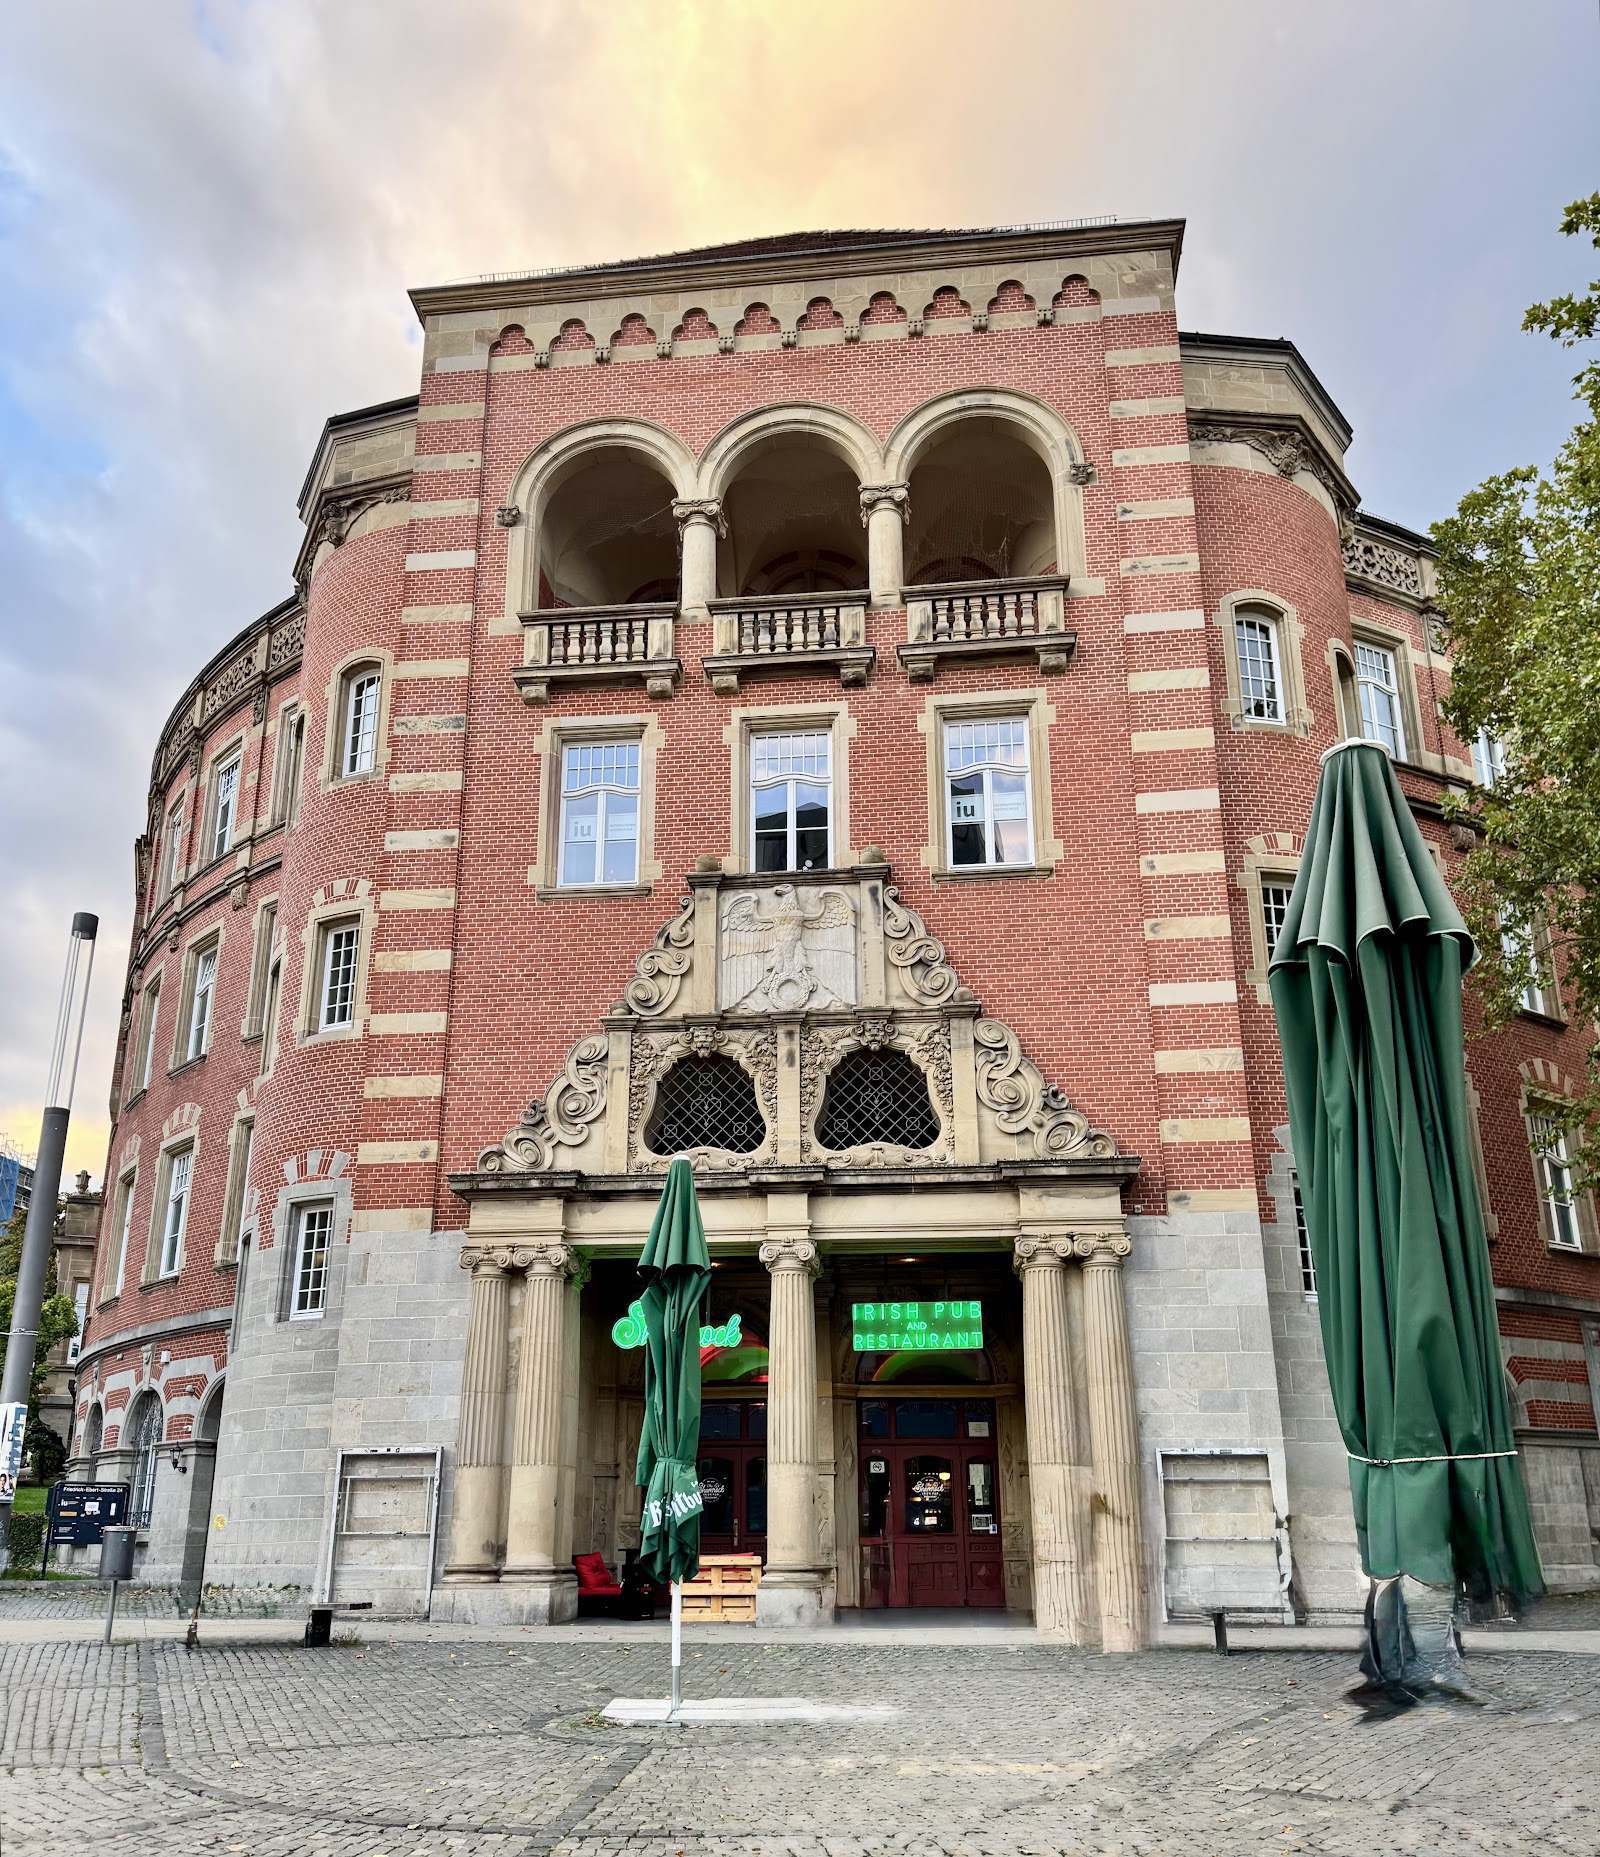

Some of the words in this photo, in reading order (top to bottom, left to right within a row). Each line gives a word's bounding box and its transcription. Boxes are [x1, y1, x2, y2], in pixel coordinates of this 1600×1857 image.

[956, 801, 975, 818] iu
[573, 820, 592, 838] iu
[852, 1303, 919, 1321] IRISH
[934, 1301, 982, 1319] PUB
[906, 1321, 928, 1331] AND
[853, 1331, 982, 1349] RESTAURANT
